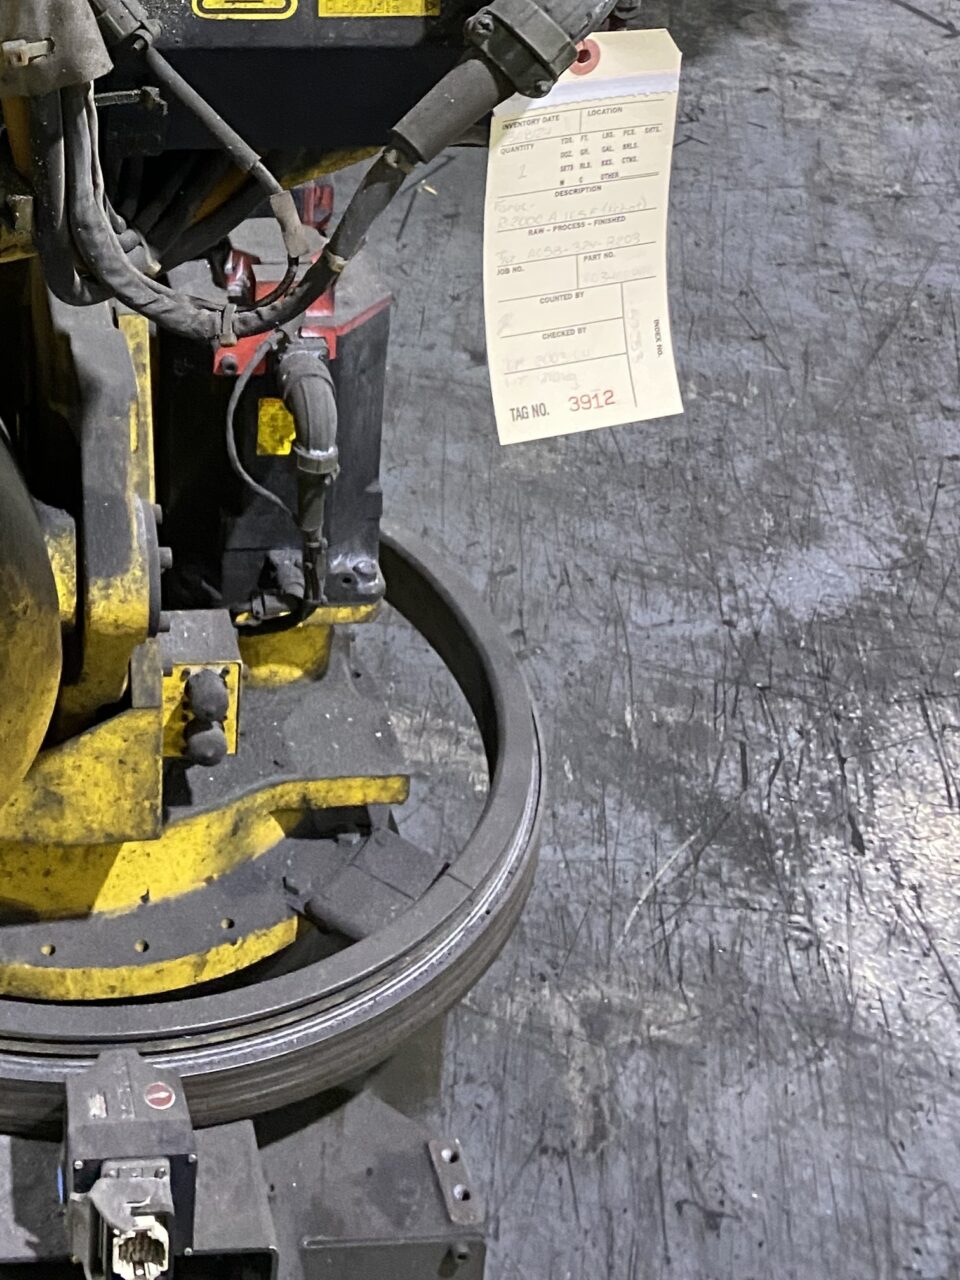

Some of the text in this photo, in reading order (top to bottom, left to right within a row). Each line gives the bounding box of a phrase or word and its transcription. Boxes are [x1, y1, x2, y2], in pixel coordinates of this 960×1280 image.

[587, 107, 623, 117] LOCATION
[502, 115, 560, 130] INVENTORY DATE
[500, 144, 534, 155] QUANTITY
[601, 172, 619, 180] OTHER
[555, 186, 602, 197] DESCRIPTION
[528, 228, 545, 236] RAW
[552, 222, 585, 232] PROCESS
[593, 216, 626, 226] FINISHED
[583, 251, 616, 262] PART NO.
[497, 265, 525, 276] JOB NO.
[540, 291, 584, 304] COUNTED BY
[542, 327, 587, 340] CHECKED BY
[654, 319, 662, 343] INDEX
[510, 390, 616, 422] TAG NO. 3912
